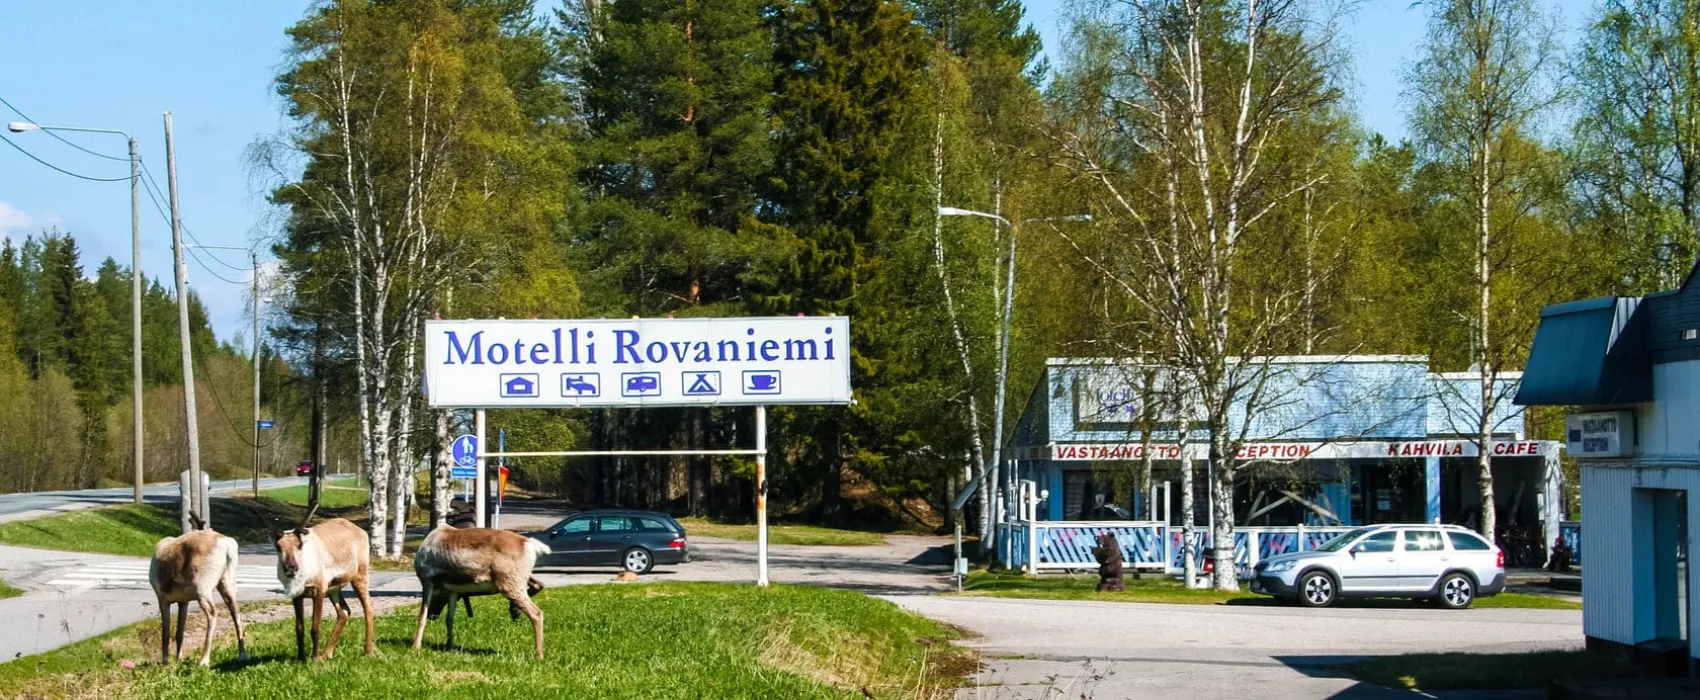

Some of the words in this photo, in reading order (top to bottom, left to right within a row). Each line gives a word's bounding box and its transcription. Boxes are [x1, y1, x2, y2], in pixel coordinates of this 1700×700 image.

[443, 328, 598, 365] Motelli
[612, 326, 836, 364] Rovaniemi
[1057, 446, 1180, 459] VASTAANOTO
[1231, 444, 1310, 458] CEPTION
[1387, 443, 1463, 456] KAHVILA
[1494, 442, 1538, 455] CAFE
